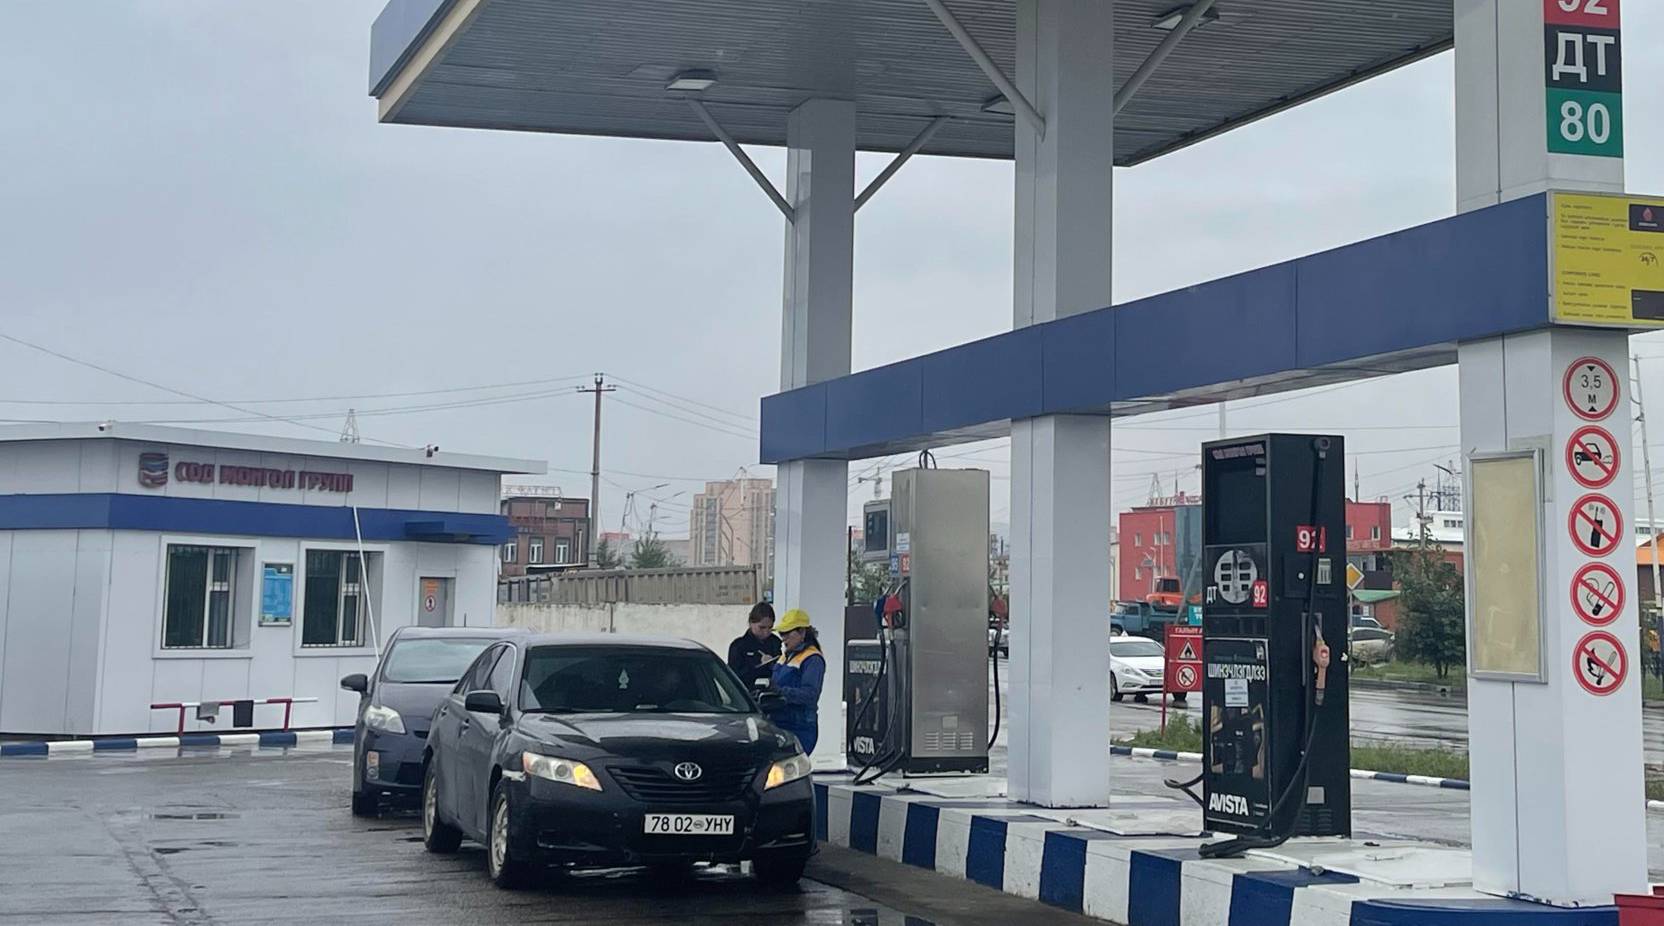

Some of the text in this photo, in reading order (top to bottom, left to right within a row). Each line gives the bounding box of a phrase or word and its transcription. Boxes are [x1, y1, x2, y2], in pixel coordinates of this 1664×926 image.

[1552, 32, 1615, 82] ДТ
[1560, 101, 1610, 144] 80
[1581, 374, 1602, 390] 3,5
[1254, 585, 1266, 603] 92
[848, 736, 875, 754] VISTA
[1208, 792, 1249, 817] AVISTA
[651, 816, 670, 832] 78
[674, 816, 693, 832] 02
